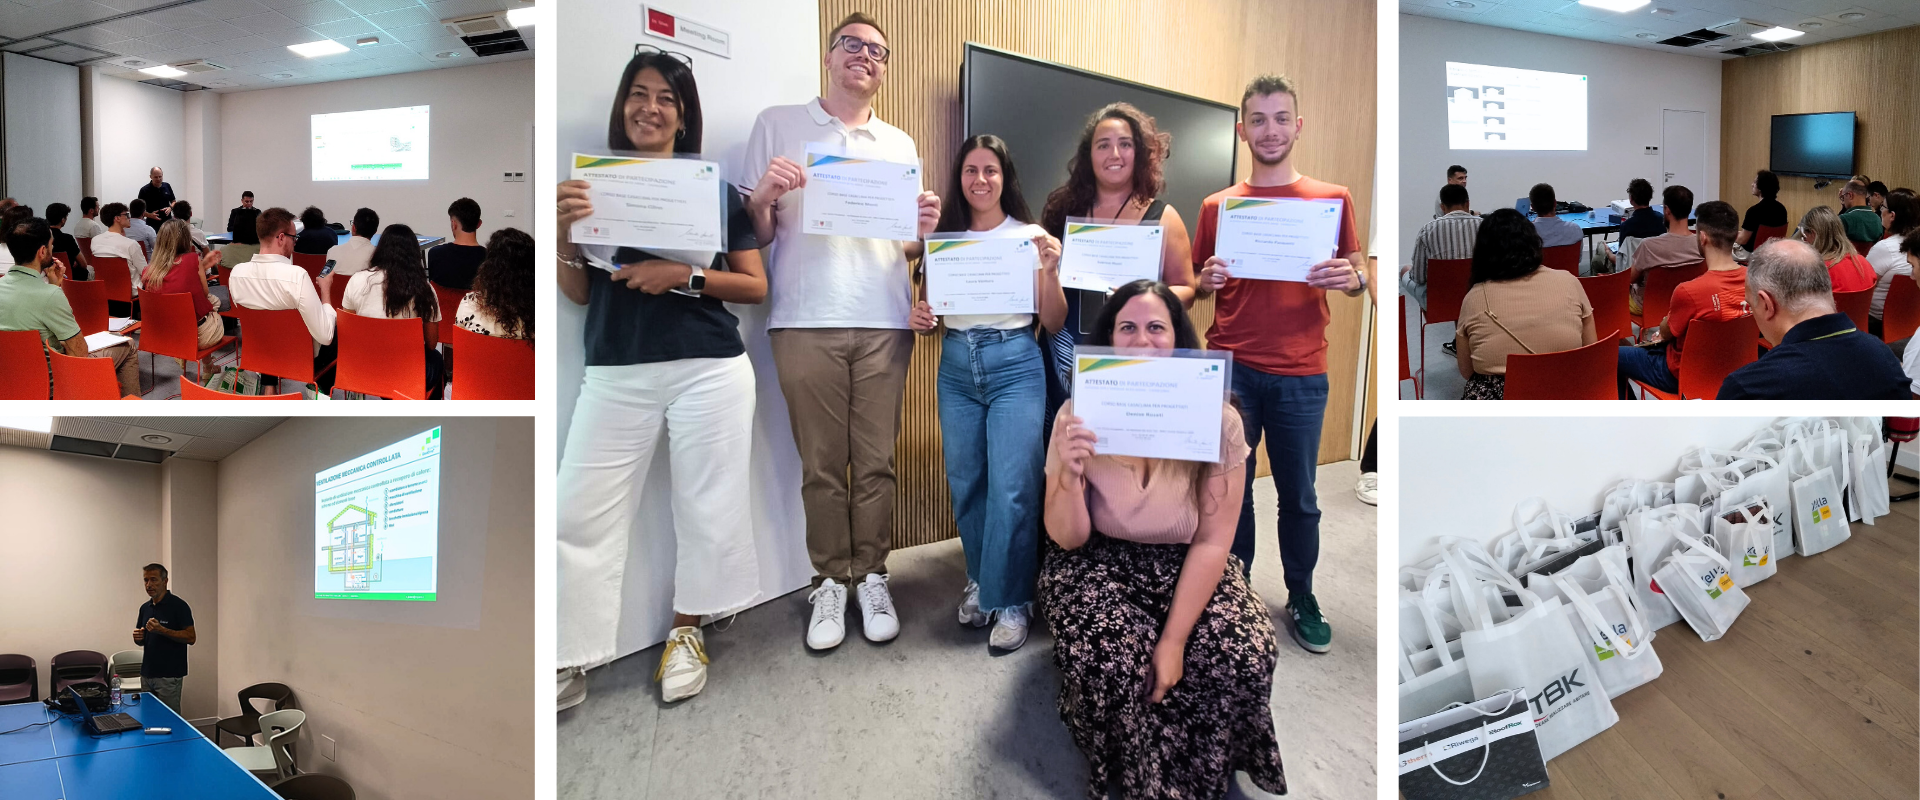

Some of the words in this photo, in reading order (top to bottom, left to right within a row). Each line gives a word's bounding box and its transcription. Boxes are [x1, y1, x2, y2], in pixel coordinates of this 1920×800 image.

[680, 25, 706, 40] Meeting
[707, 34, 726, 45] Room
[626, 175, 676, 185] PARTECIPAZIONE
[813, 172, 841, 180] ATTESTATO
[848, 177, 888, 186] PARTECIPAZIONE
[341, 465, 366, 478] MECCANICA
[366, 452, 402, 468] CONTROLLATA
[1529, 667, 1585, 716] TBK
[1573, 690, 1590, 703] ABITARE
[1450, 736, 1479, 749] Riwega
